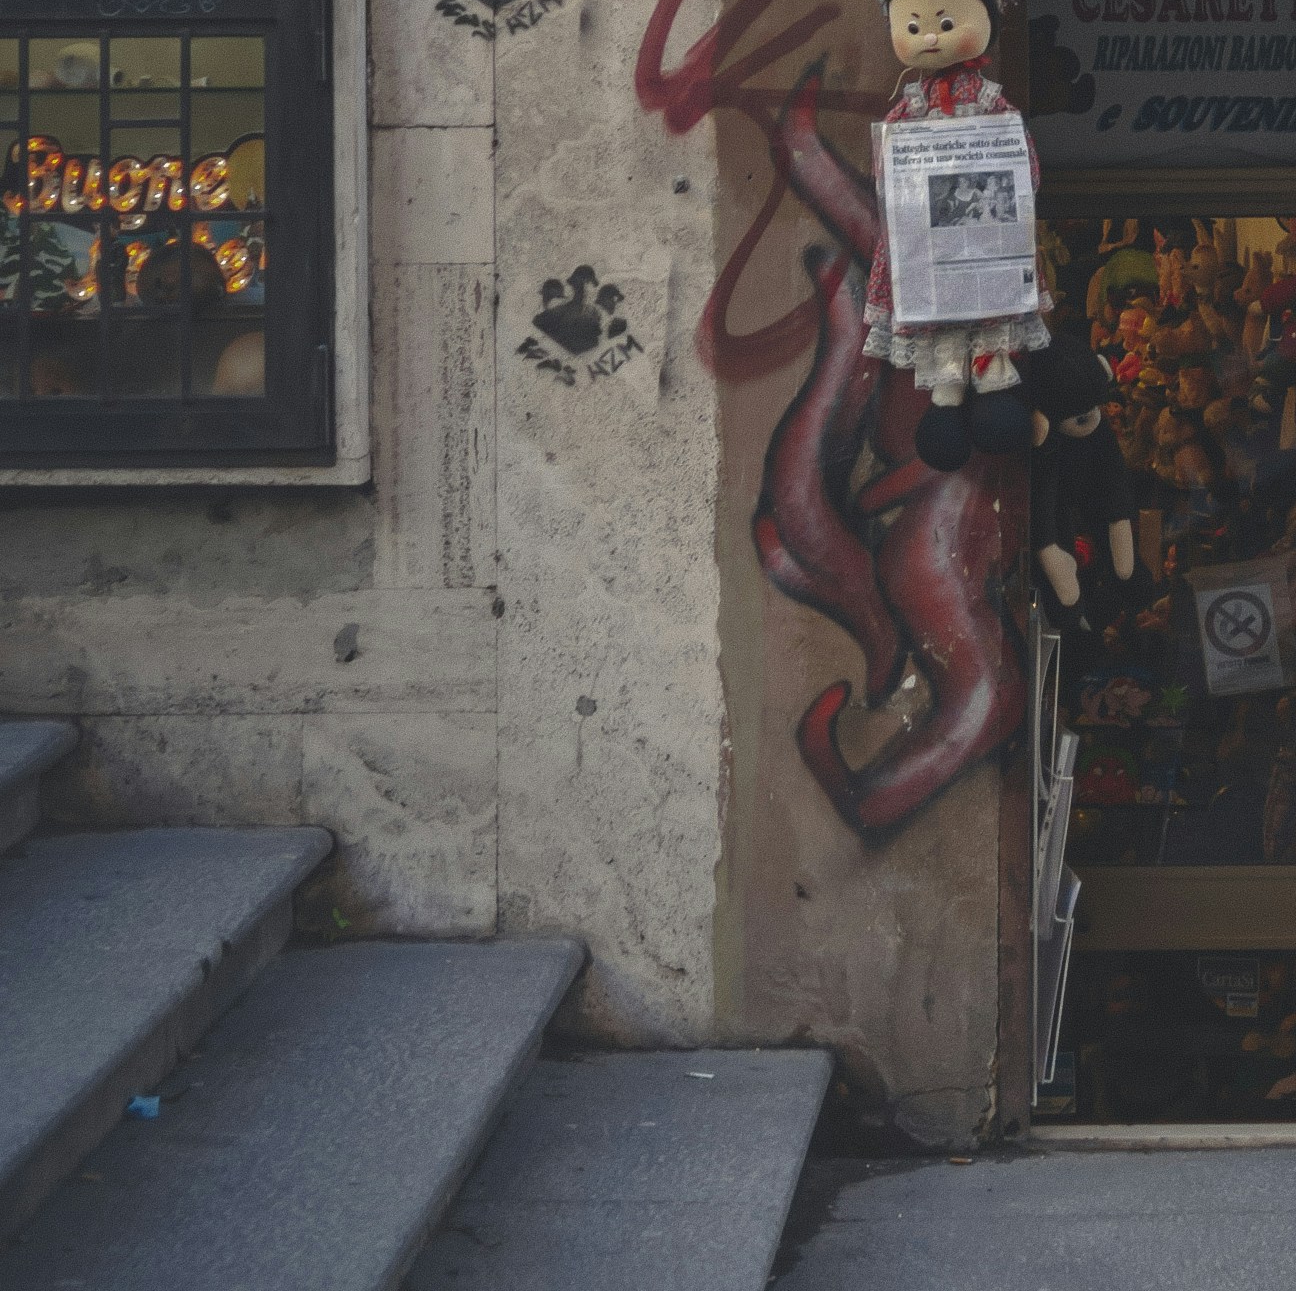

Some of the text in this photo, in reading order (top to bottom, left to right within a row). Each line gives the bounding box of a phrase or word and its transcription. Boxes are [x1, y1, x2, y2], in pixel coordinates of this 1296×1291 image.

[1092, 34, 1227, 71] RIPARAZIONI
[932, 140, 967, 151] storiche
[969, 138, 990, 148] sotto
